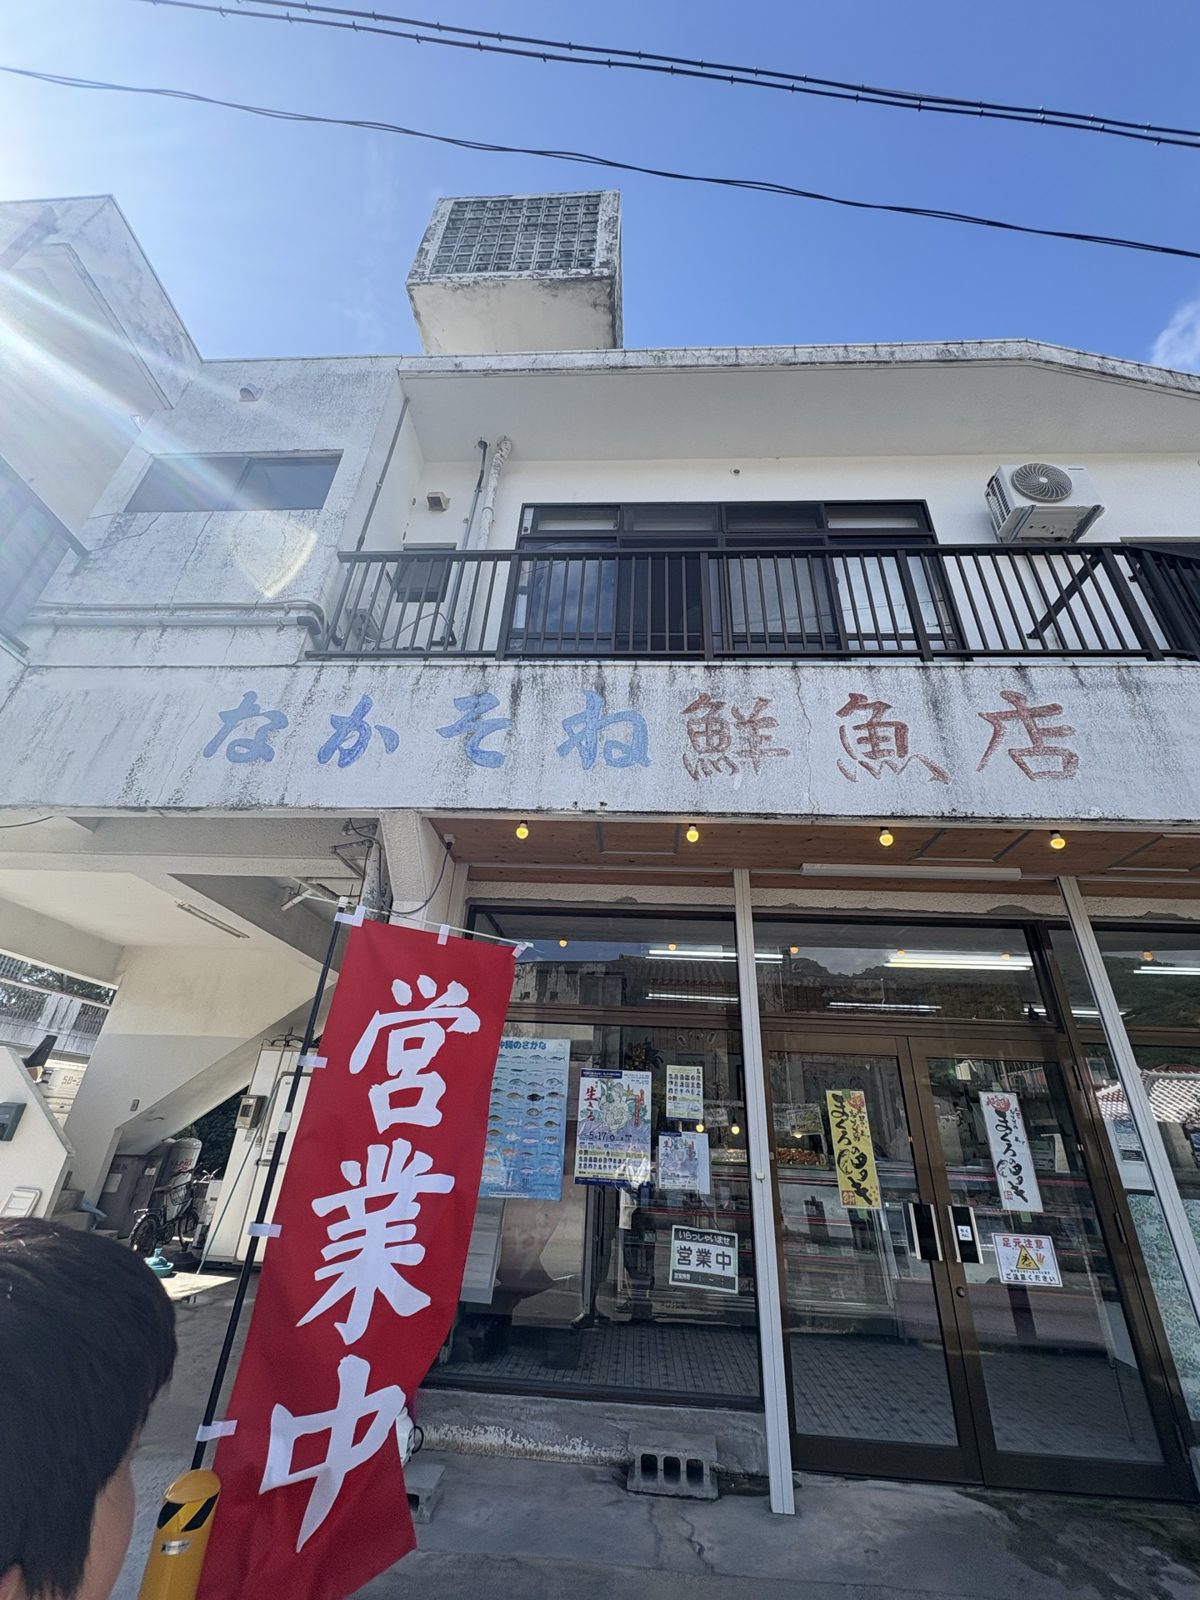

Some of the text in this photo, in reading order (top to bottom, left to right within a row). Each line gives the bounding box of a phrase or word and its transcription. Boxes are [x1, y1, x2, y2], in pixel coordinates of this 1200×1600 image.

[678, 1230, 731, 1245] いらっしゃいませ
[1002, 1237, 1044, 1249] 足元注意
[258, 973, 481, 1554] 営業中
[676, 1245, 732, 1271] 営業中
[1006, 1273, 1056, 1282] ご注意ください
